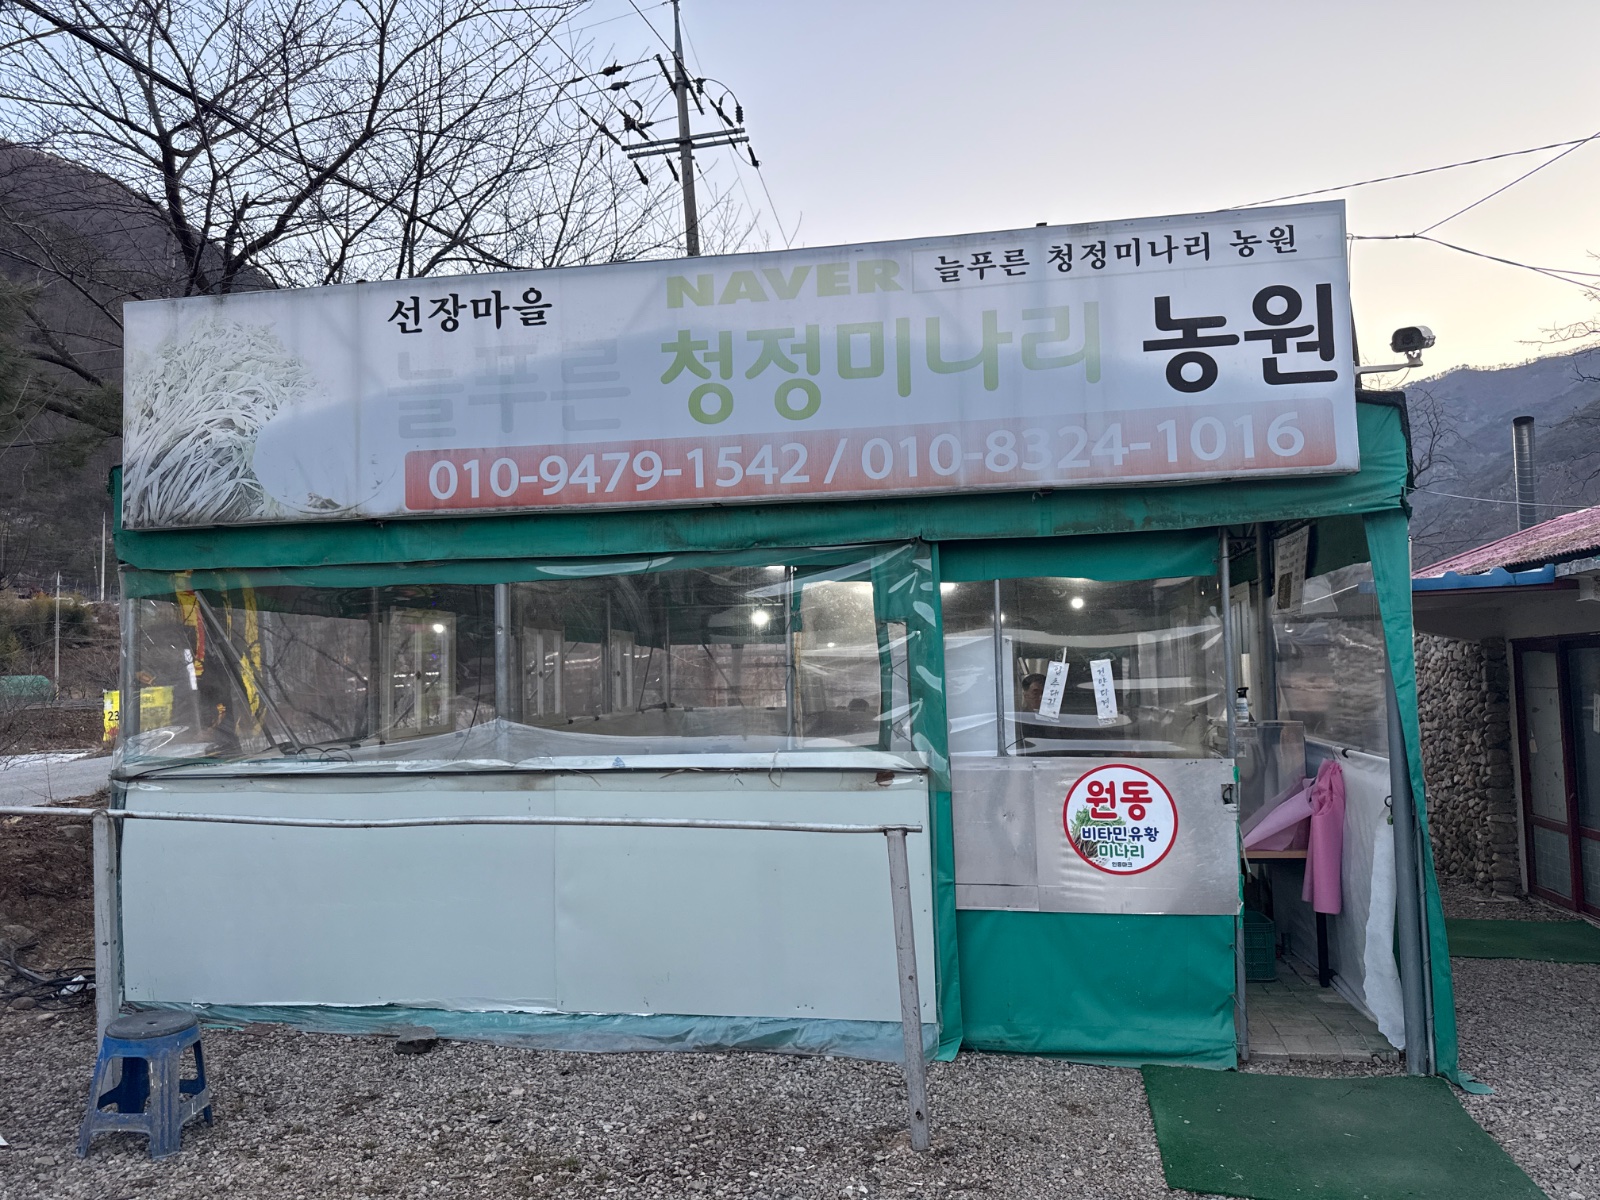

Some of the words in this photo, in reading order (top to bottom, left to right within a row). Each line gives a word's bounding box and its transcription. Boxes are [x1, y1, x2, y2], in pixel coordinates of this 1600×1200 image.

[934, 249, 1030, 283] 늘푸른
[1046, 231, 1211, 273] 청정미나리
[1229, 224, 1298, 257] 농원
[666, 259, 904, 309] NAVER
[387, 286, 553, 335] 선장마을
[387, 338, 631, 439] 늘푸른
[660, 301, 1102, 425] 청정미나리
[1142, 282, 1339, 393] 농원
[427, 439, 811, 501] 010-9479-1542
[861, 410, 1307, 481] 010-8324-1016
[1085, 780, 1153, 821] 원동
[1081, 826, 1159, 842] 비타민유황
[1098, 844, 1145, 859] 미나리
